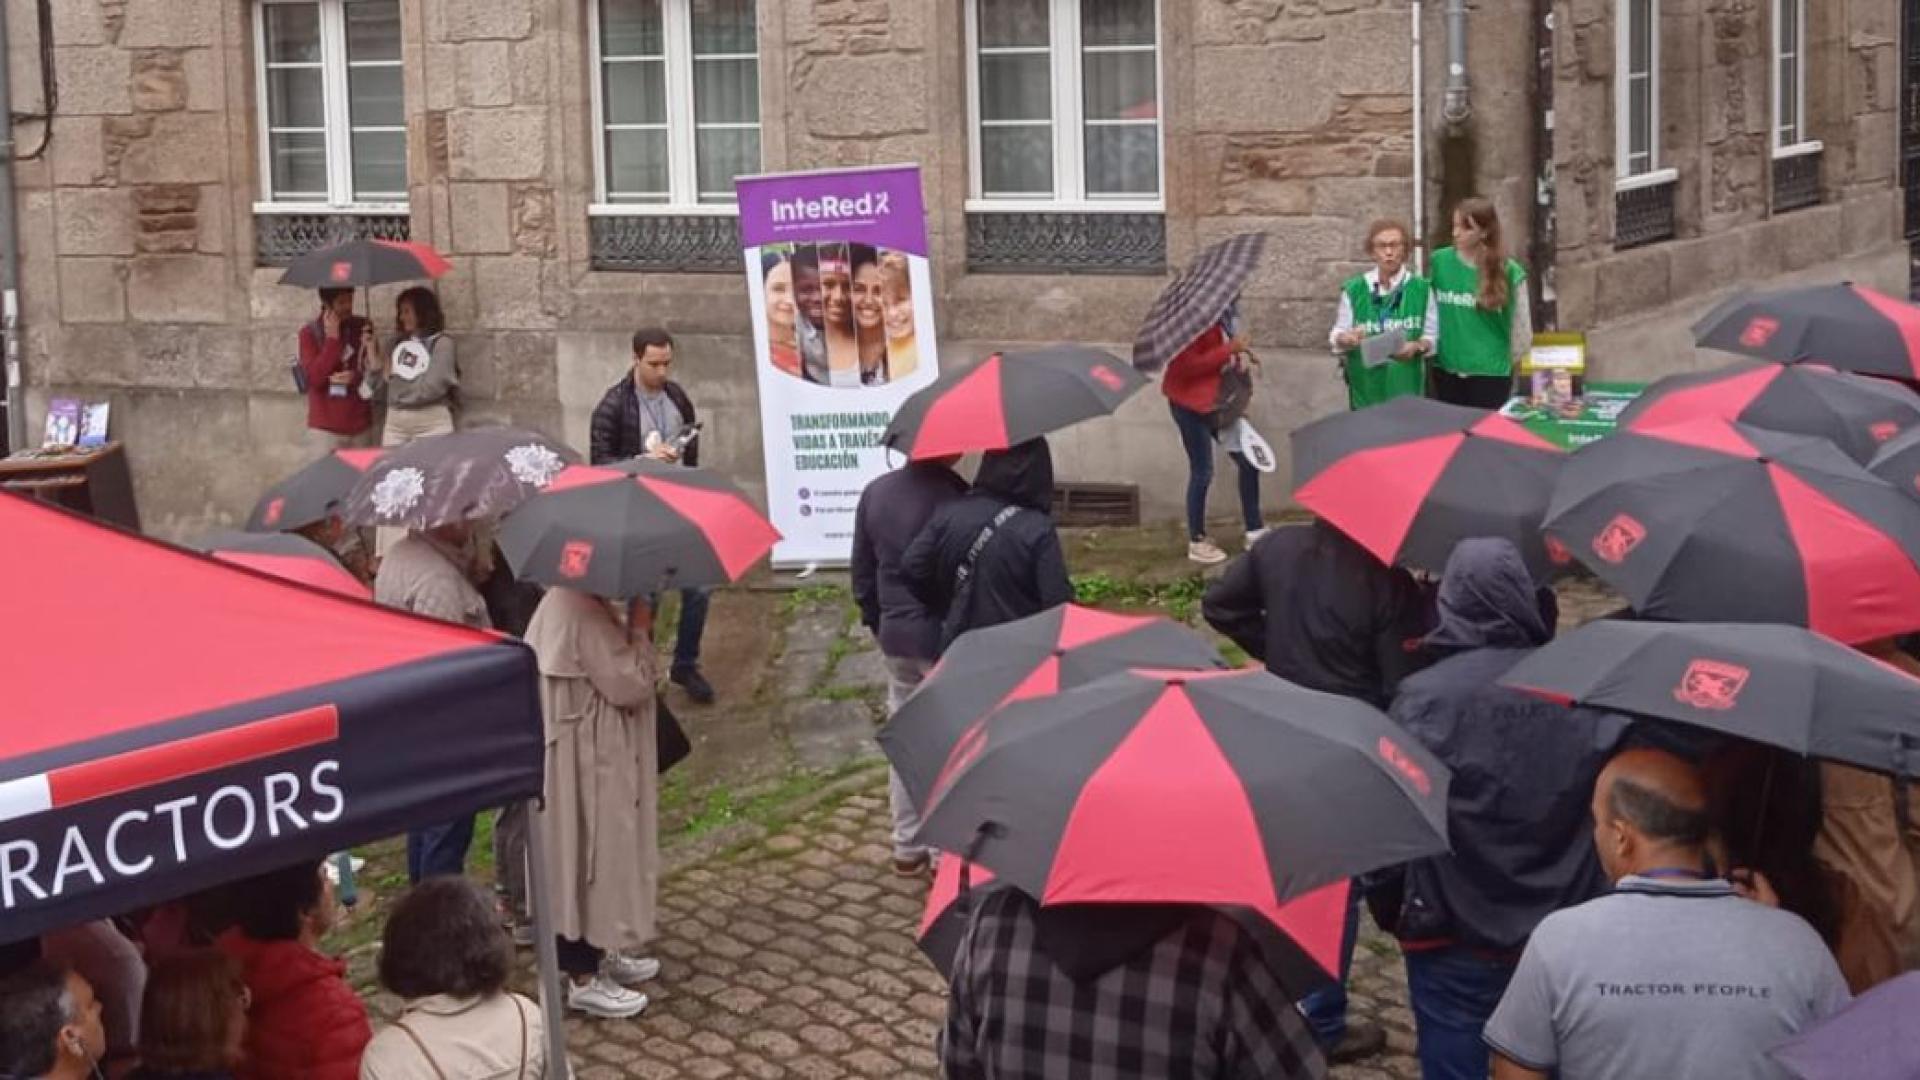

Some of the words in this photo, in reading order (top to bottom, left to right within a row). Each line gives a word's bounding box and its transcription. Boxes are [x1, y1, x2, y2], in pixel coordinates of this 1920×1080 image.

[771, 193, 872, 222] InteRed
[791, 411, 889, 430] TRANSFORMANDO
[793, 433, 826, 449] VIDAS
[828, 433, 837, 449] A
[795, 450, 859, 471] EDUCACIÓN
[0, 760, 344, 909] RACTORS
[1595, 982, 1686, 997] TRACTOR
[1694, 982, 1771, 999] PEOPLE
